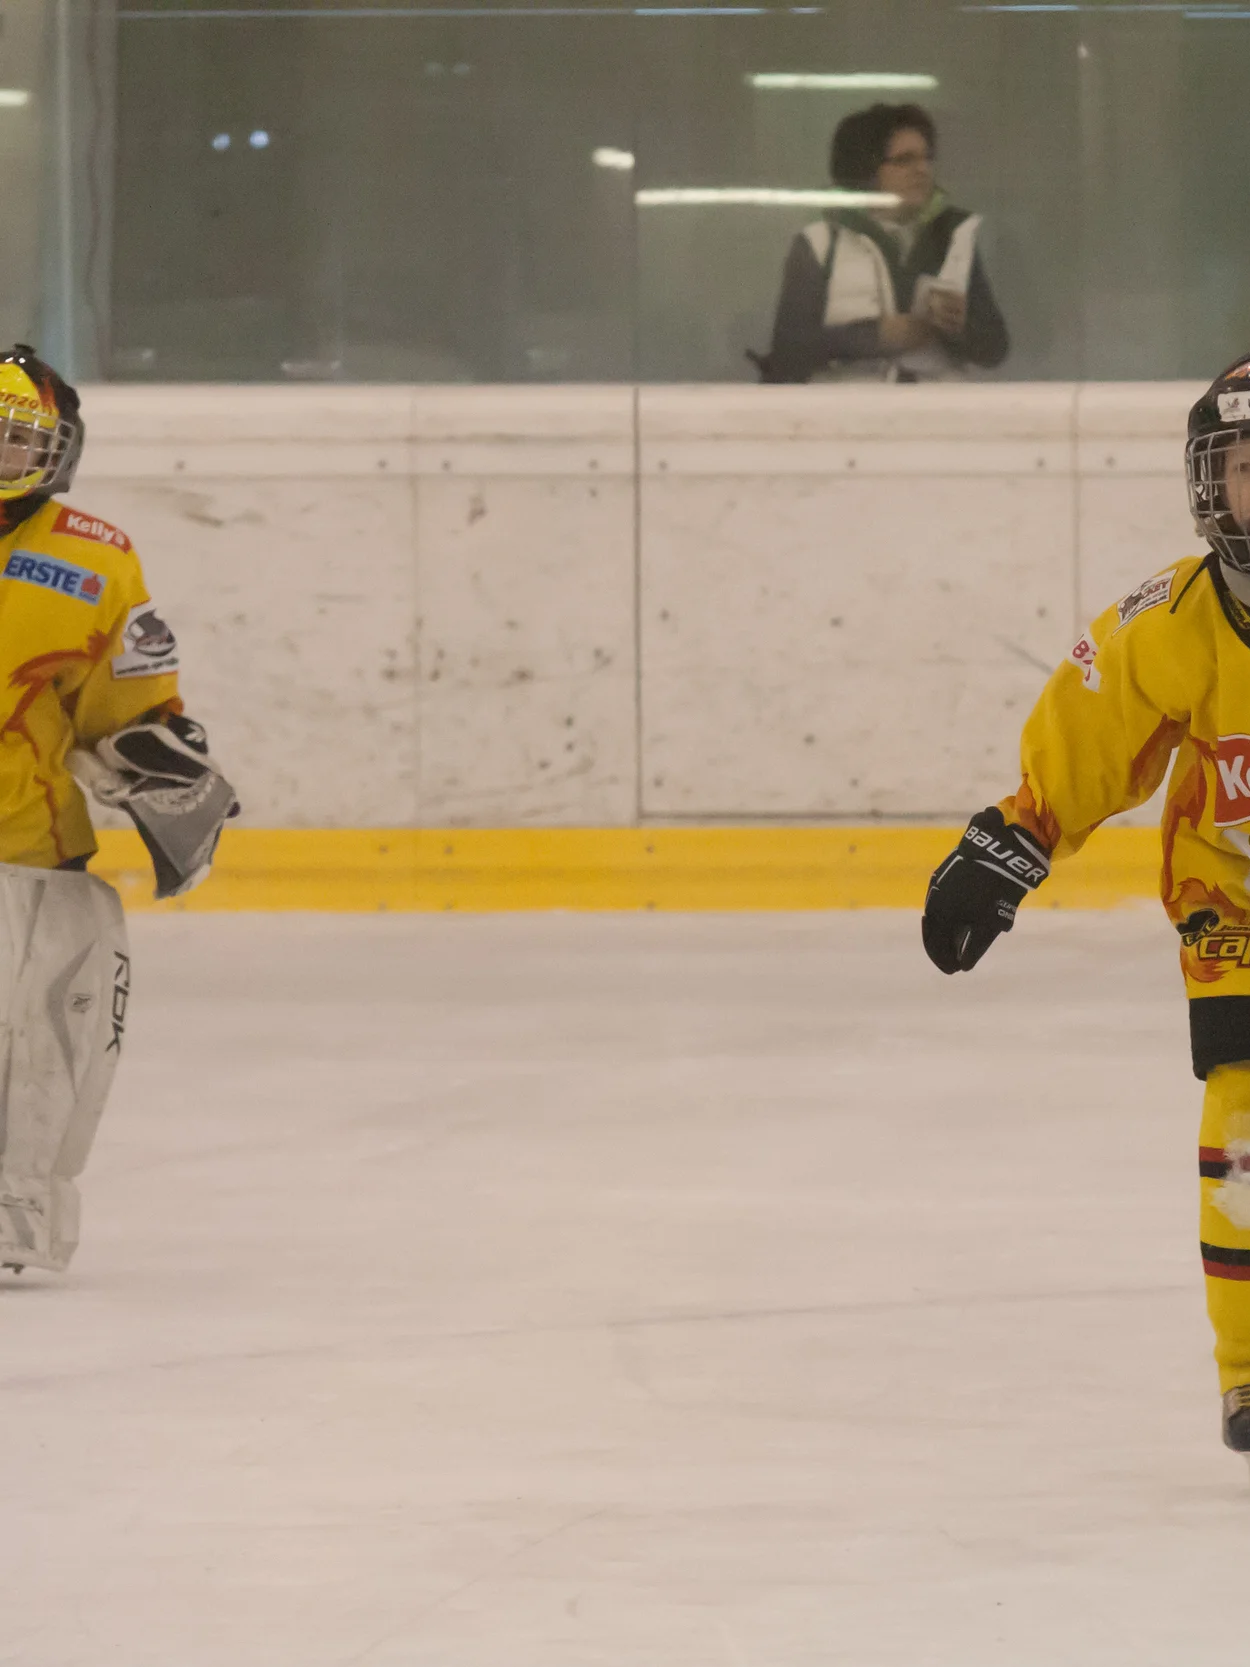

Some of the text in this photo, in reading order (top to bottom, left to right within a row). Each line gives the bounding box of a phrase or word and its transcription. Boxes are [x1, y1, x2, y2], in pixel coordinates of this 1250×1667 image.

[66, 513, 126, 547] Kelly's
[4, 555, 82, 594] ERSTE
[964, 825, 1047, 882] BAUER
